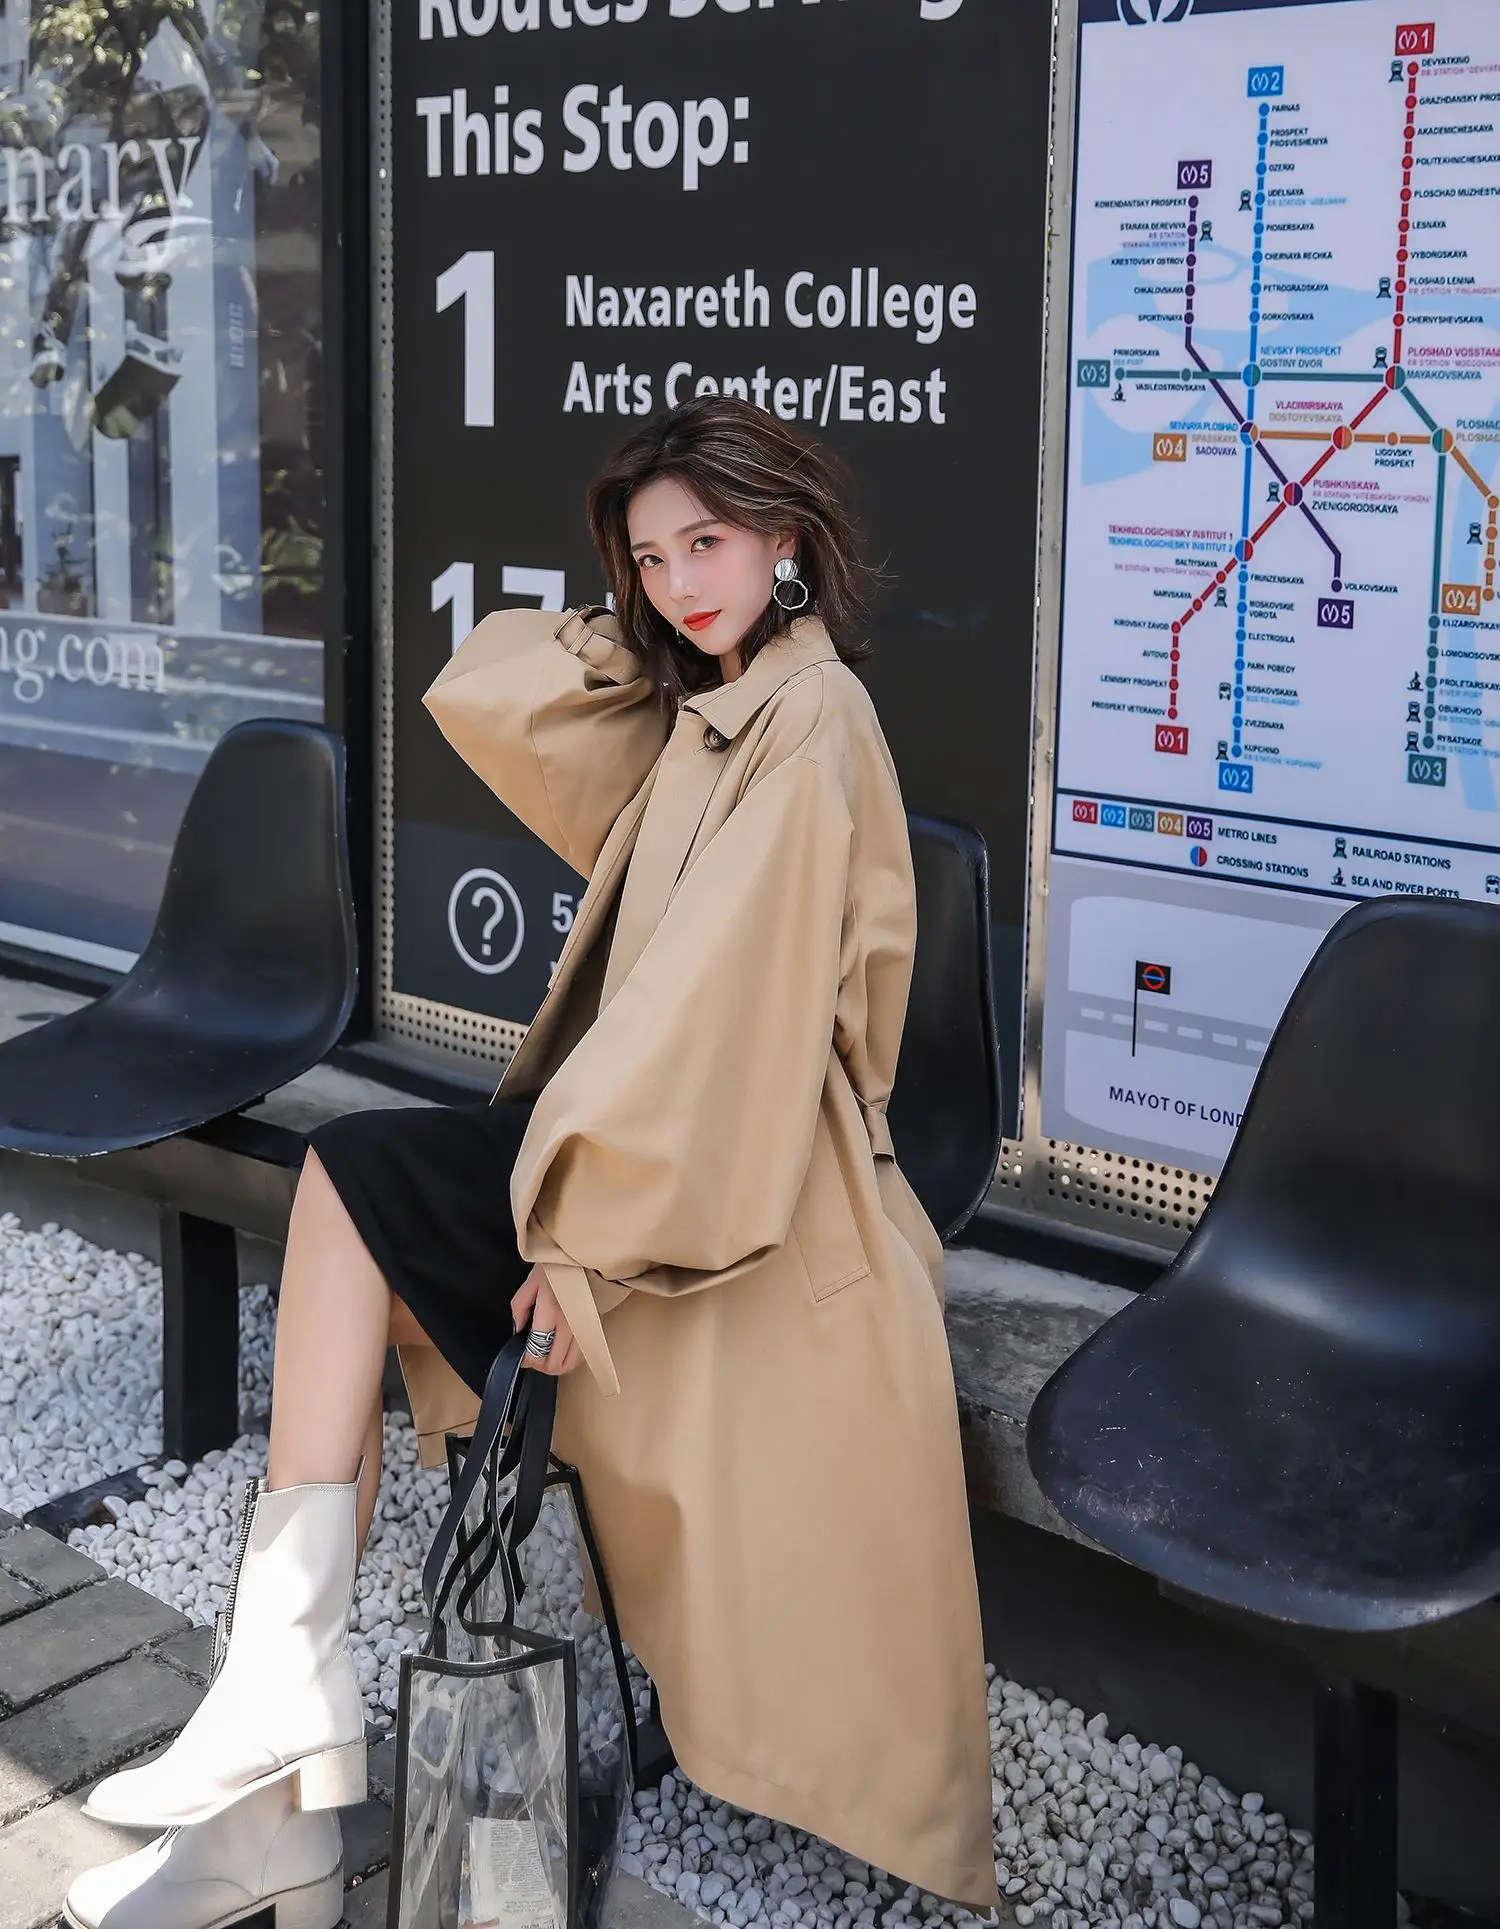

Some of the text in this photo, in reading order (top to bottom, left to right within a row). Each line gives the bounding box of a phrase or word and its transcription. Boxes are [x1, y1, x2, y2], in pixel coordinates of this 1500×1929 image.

[1270, 104, 1301, 113] PARNAS
[416, 83, 750, 192] This Stop:
[1411, 220, 1447, 230] LESNAYA
[565, 267, 977, 345] Naxareth College
[436, 250, 495, 428] 1
[1260, 345, 1342, 356] NEVSKY PROSPEKT
[1407, 346, 1453, 358] PLOSHAD
[1259, 358, 1324, 369] GOSTINY DVOR
[1406, 369, 1483, 381] MAYAKOVSKAYA
[562, 361, 653, 416] Arts
[1275, 401, 1344, 411] VLADIMIRSKAYA
[1195, 446, 1237, 456] SADOVAYA
[1374, 459, 1415, 469] PROSPEKT
[1312, 479, 1380, 491] PUSHKINSKAYA
[1192, 530, 1227, 541] INSTITUT
[1344, 582, 1399, 594] VOLKOVSKAYA
[1248, 610, 1278, 620] VOROTA
[1441, 649, 1500, 662] LOMONOSOVSK
[1246, 661, 1297, 675] PARK POBEDY
[1217, 827, 1250, 842] METRO
[1251, 831, 1279, 845] LINES
[1352, 845, 1452, 870] RAILROAD STATIONS
[1216, 854, 1310, 879] CROSSING STATIONS
[1351, 874, 1460, 899] SEA AND RIVER PORTS
[551, 891, 584, 934] 5
[1109, 1085, 1170, 1112] MAYOT
[1174, 1099, 1197, 1117] OF
